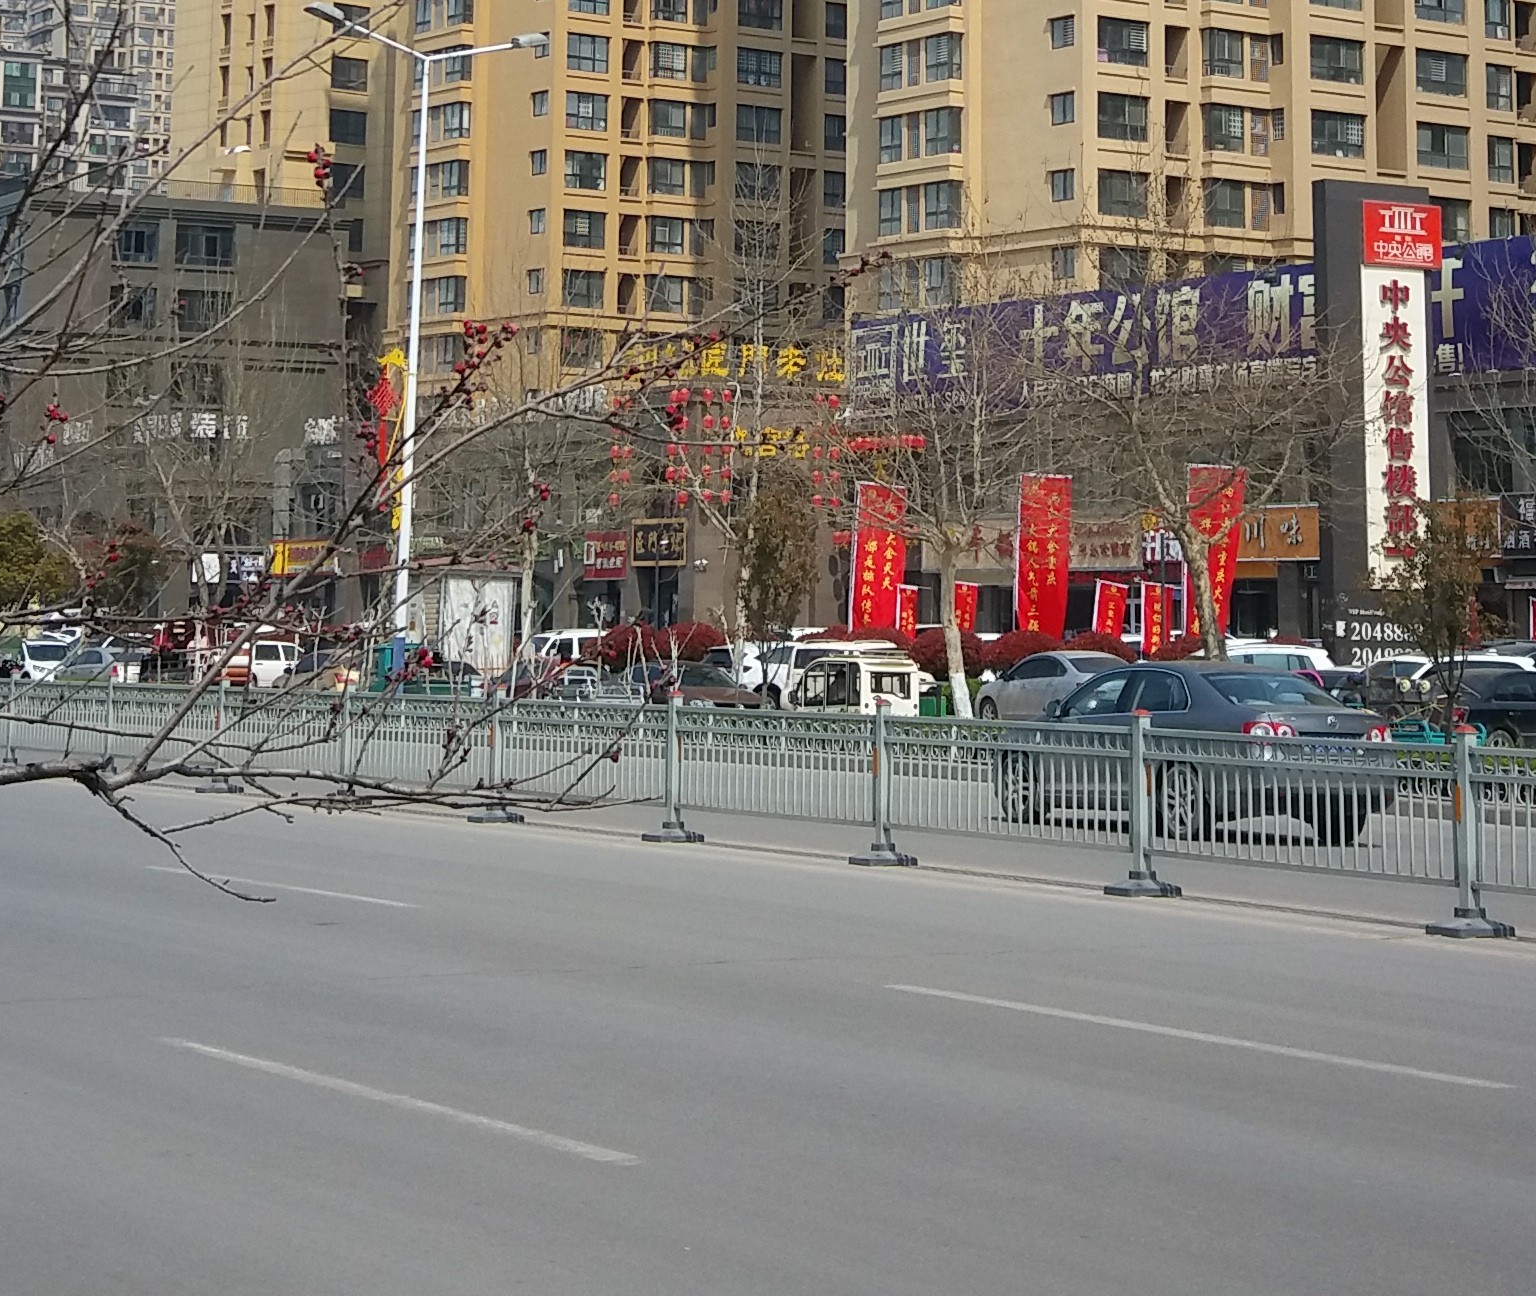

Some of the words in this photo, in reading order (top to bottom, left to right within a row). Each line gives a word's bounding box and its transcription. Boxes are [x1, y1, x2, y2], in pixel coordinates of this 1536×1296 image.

[1379, 279, 1419, 534] 中央公馆售楼部
